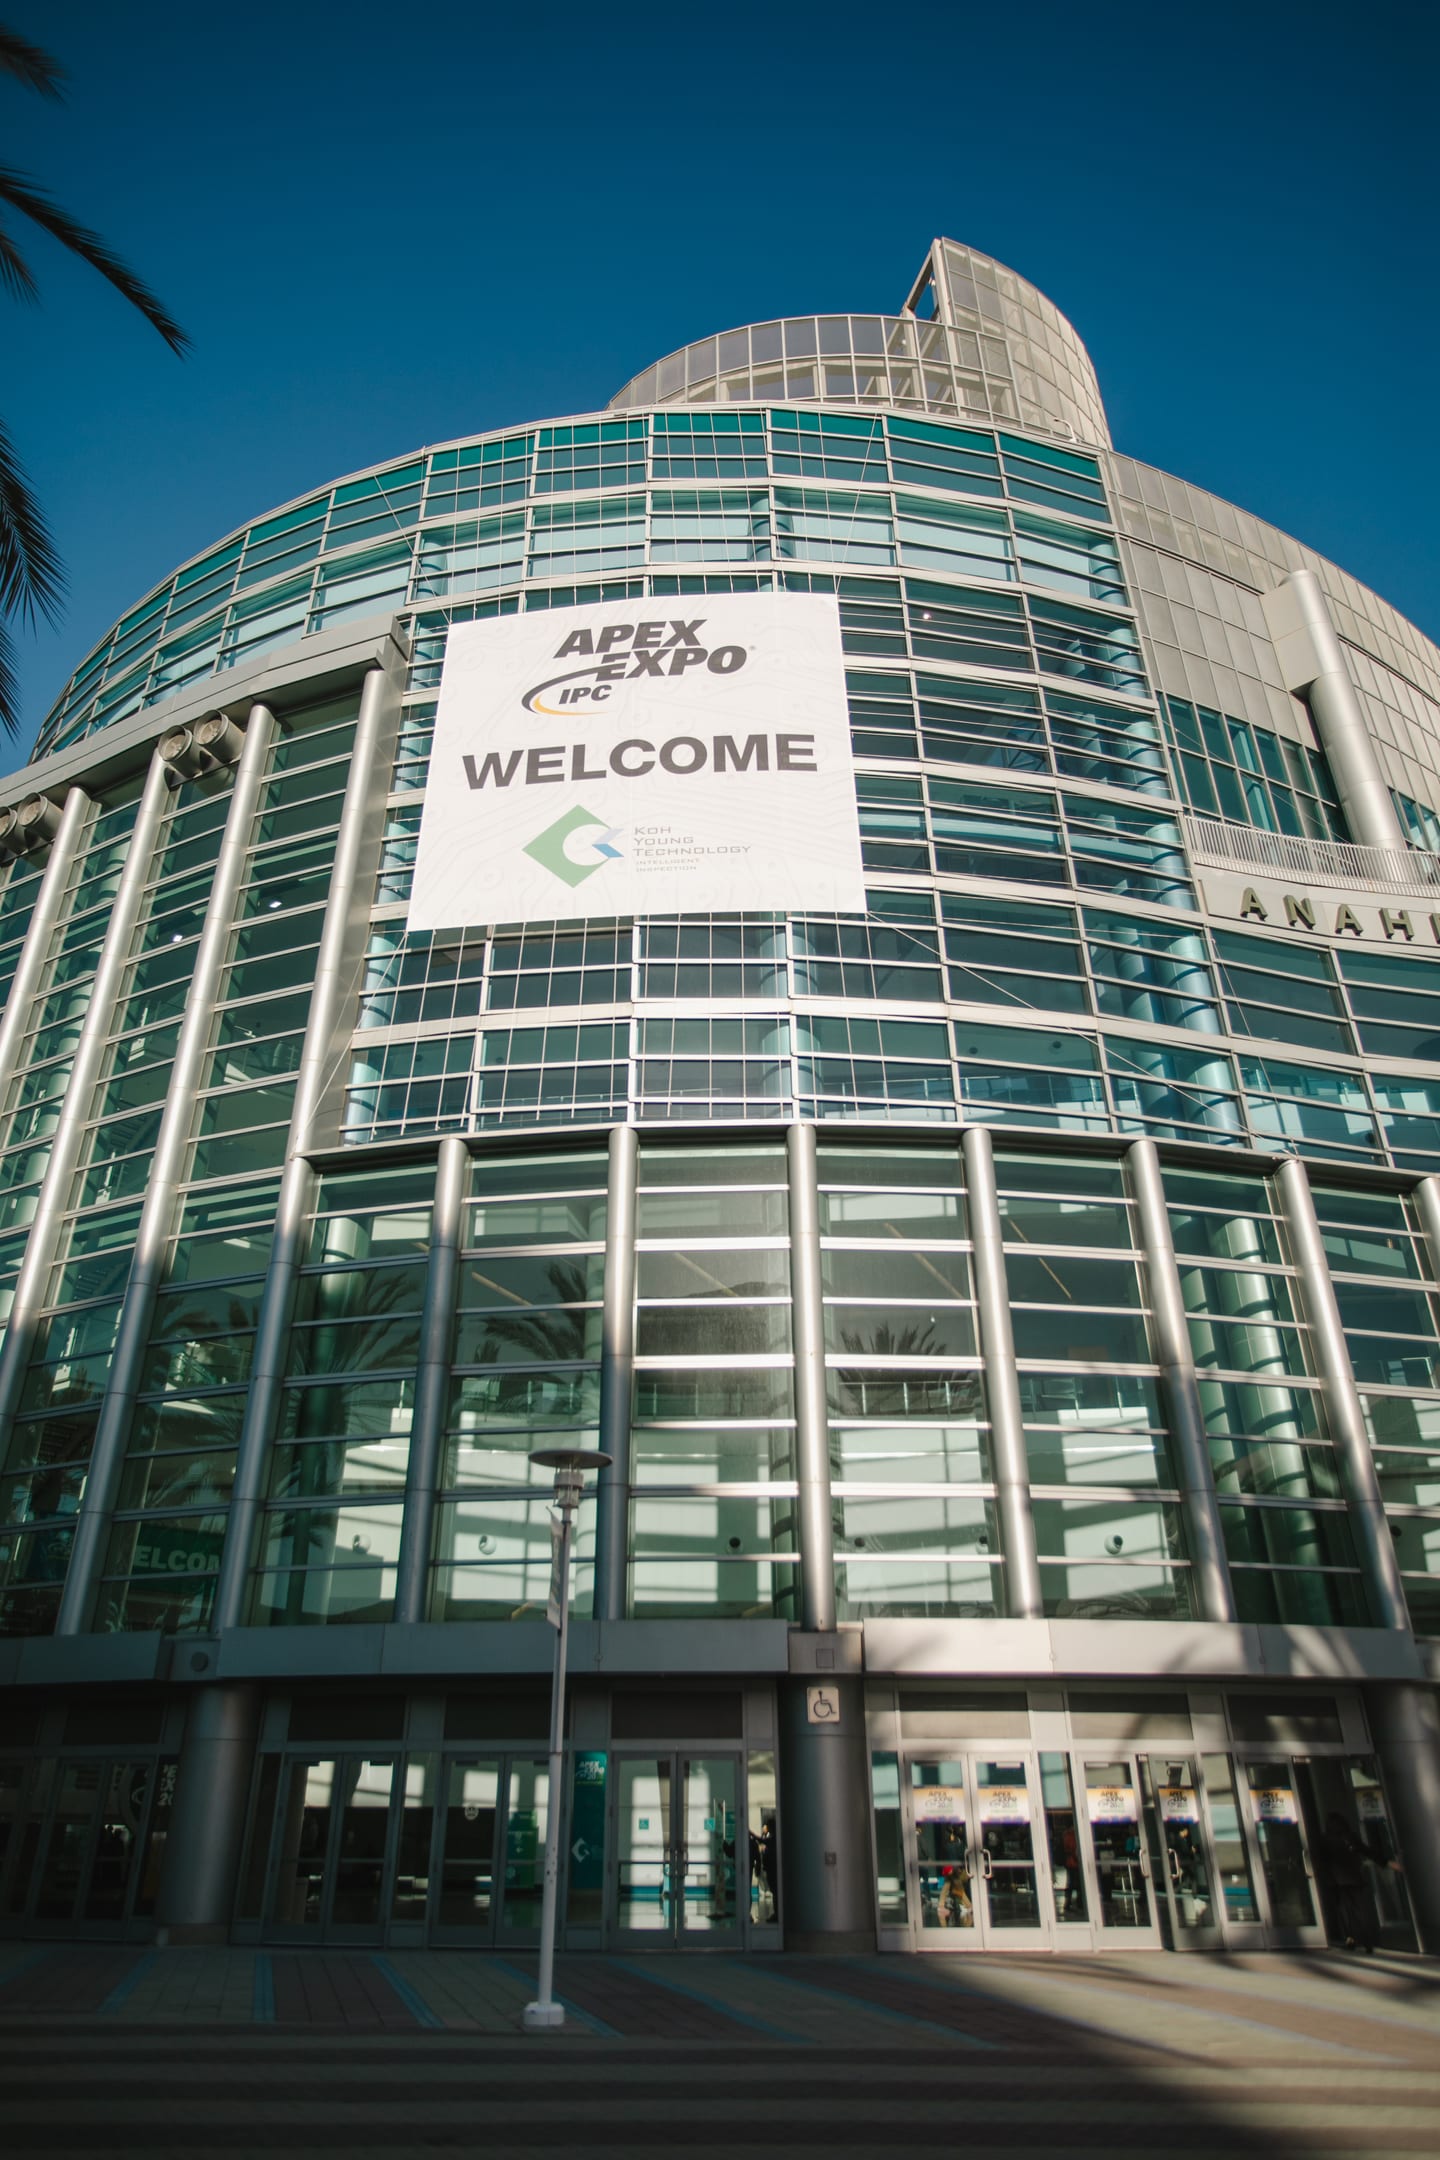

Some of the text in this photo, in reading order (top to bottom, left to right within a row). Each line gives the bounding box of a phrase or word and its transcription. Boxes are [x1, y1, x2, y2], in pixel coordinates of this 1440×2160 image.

[552, 619, 708, 659] APEX
[594, 645, 747, 682] EXPO
[558, 684, 612, 705] IPC
[461, 733, 818, 790] WELCOME
[633, 836, 694, 846] YOUNG
[634, 826, 671, 835] KOH
[632, 846, 751, 857] TECHNOLOGY
